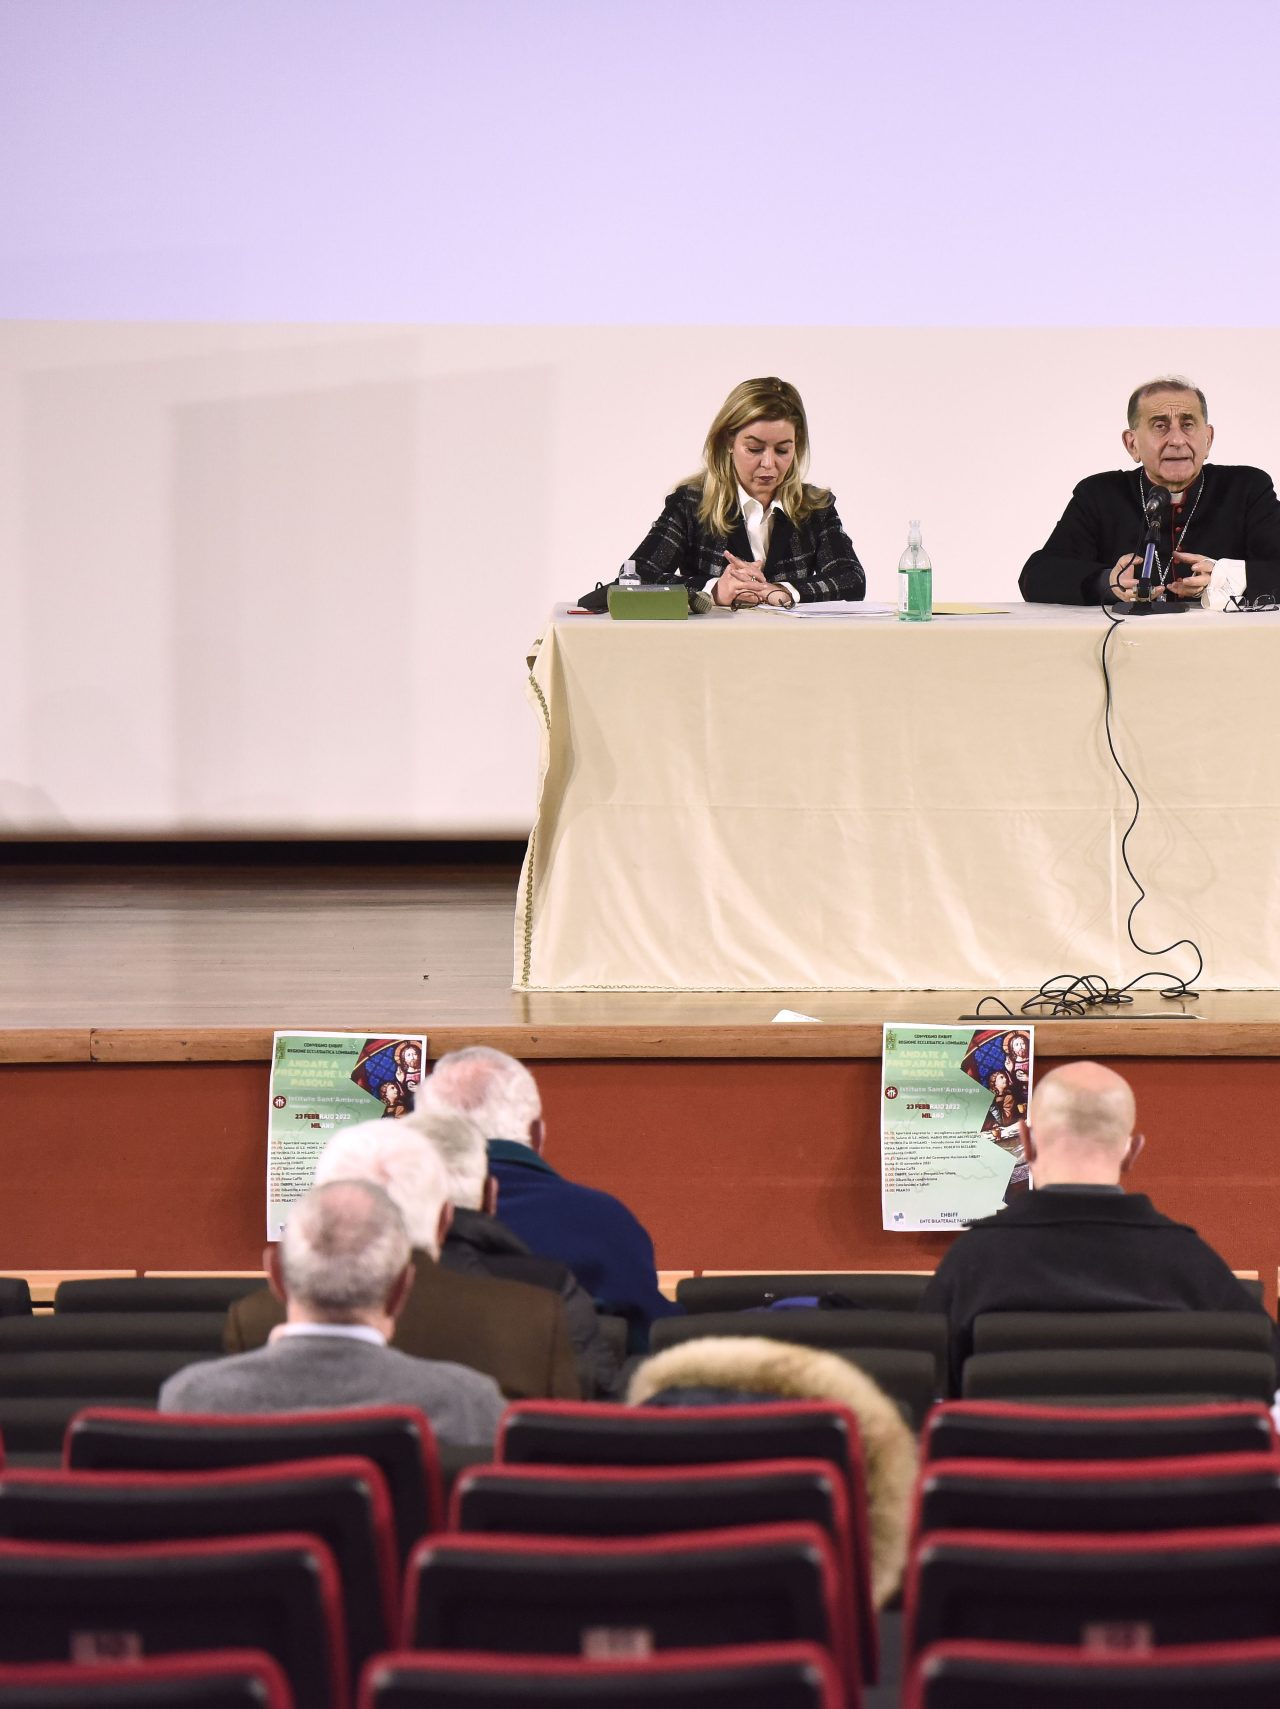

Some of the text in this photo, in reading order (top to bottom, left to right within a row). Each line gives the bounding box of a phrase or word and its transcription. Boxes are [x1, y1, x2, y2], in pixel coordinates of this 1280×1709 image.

[288, 1060, 339, 1069] ANDATE A
[886, 1060, 960, 1068] PREPARARE LA
[275, 1069, 351, 1078] PREPARARE LA
[902, 1069, 944, 1077] PASQUA
[290, 1079, 334, 1087] PASQUA
[317, 1096, 371, 1104] Sant'Ambrogio
